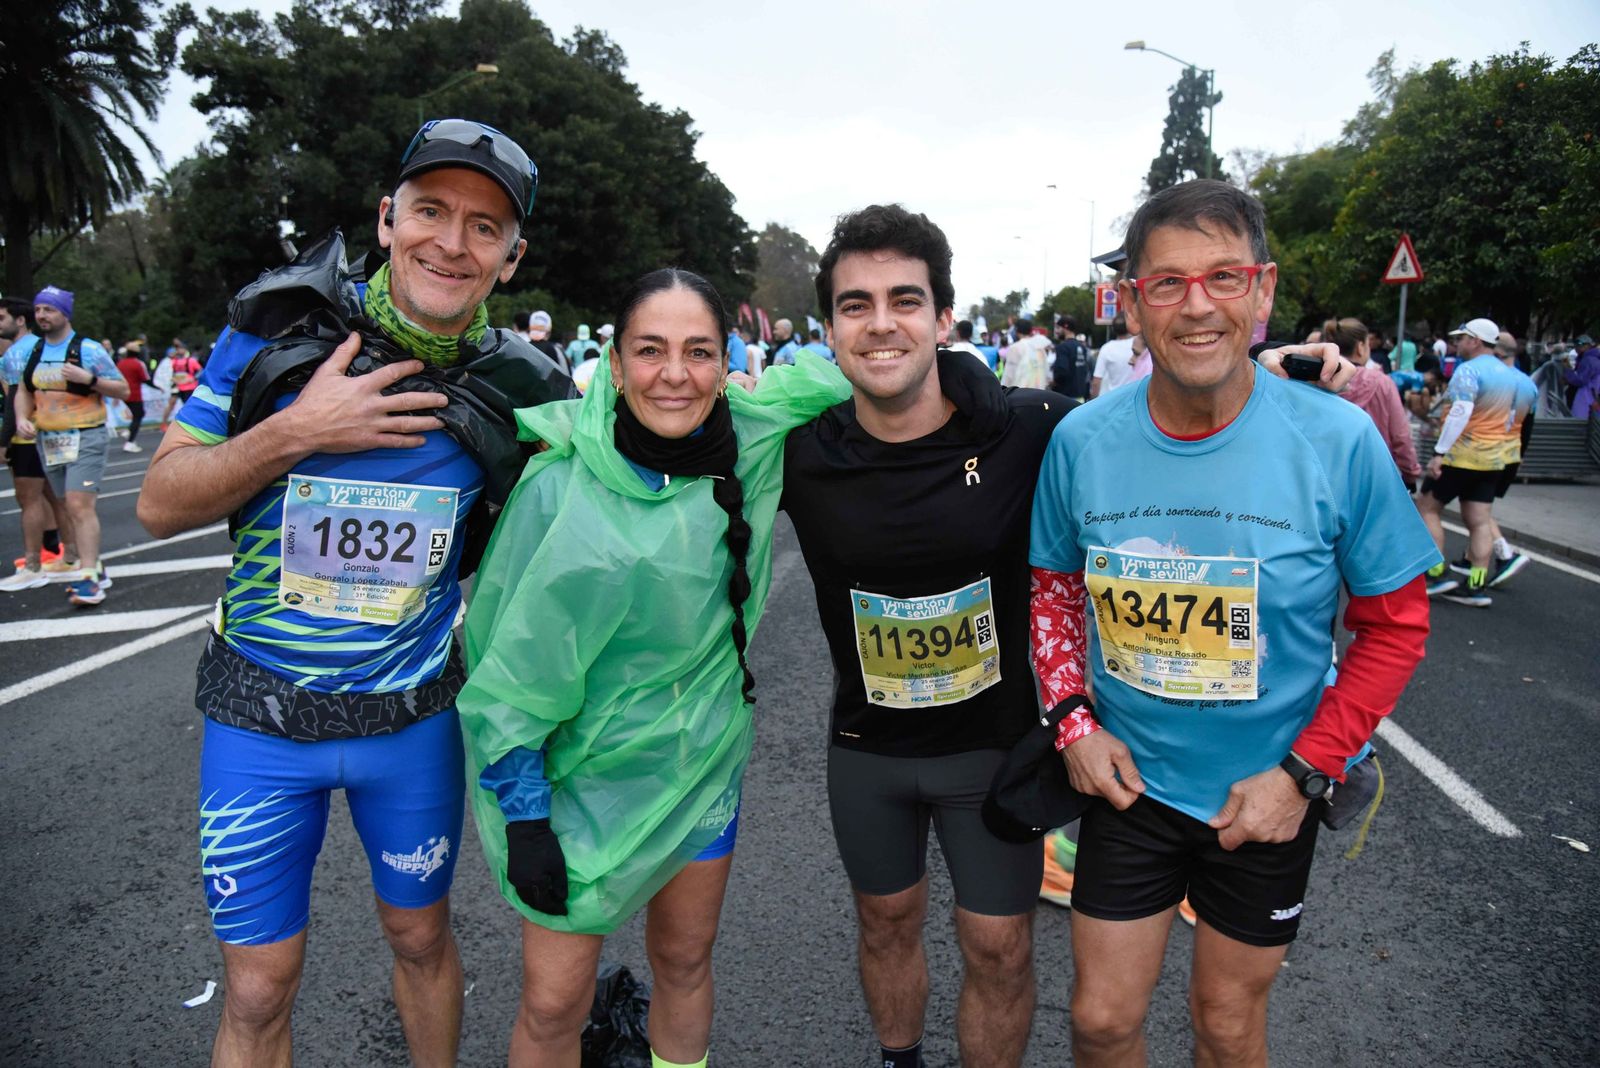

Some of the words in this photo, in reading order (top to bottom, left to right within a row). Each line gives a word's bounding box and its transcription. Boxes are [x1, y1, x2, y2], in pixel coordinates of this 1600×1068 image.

[348, 486, 407, 499] maratón
[360, 495, 406, 507] sevilla
[1084, 510, 1126, 526] Empieza
[1128, 506, 1139, 518] el
[1142, 505, 1162, 517] día
[1165, 507, 1222, 519] sonriendo
[1225, 512, 1235, 522] y
[313, 516, 417, 564] 1832
[343, 563, 380, 574] Gonzalo
[1136, 559, 1196, 572] maratón
[314, 572, 350, 583] Gonzalo
[351, 574, 379, 587] López
[380, 577, 408, 587] Zabala
[1149, 567, 1196, 580] sevilla
[334, 604, 359, 613] HOKA
[896, 599, 946, 611] maratón
[1101, 587, 1228, 636] 13474
[906, 607, 946, 618] sevilla
[869, 616, 975, 661] 11394
[1145, 632, 1180, 645] Ninguno
[1122, 641, 1152, 654] Antonio
[1174, 650, 1207, 659] Rosado
[1141, 677, 1162, 688] HOKA
[911, 695, 932, 703] HOKA
